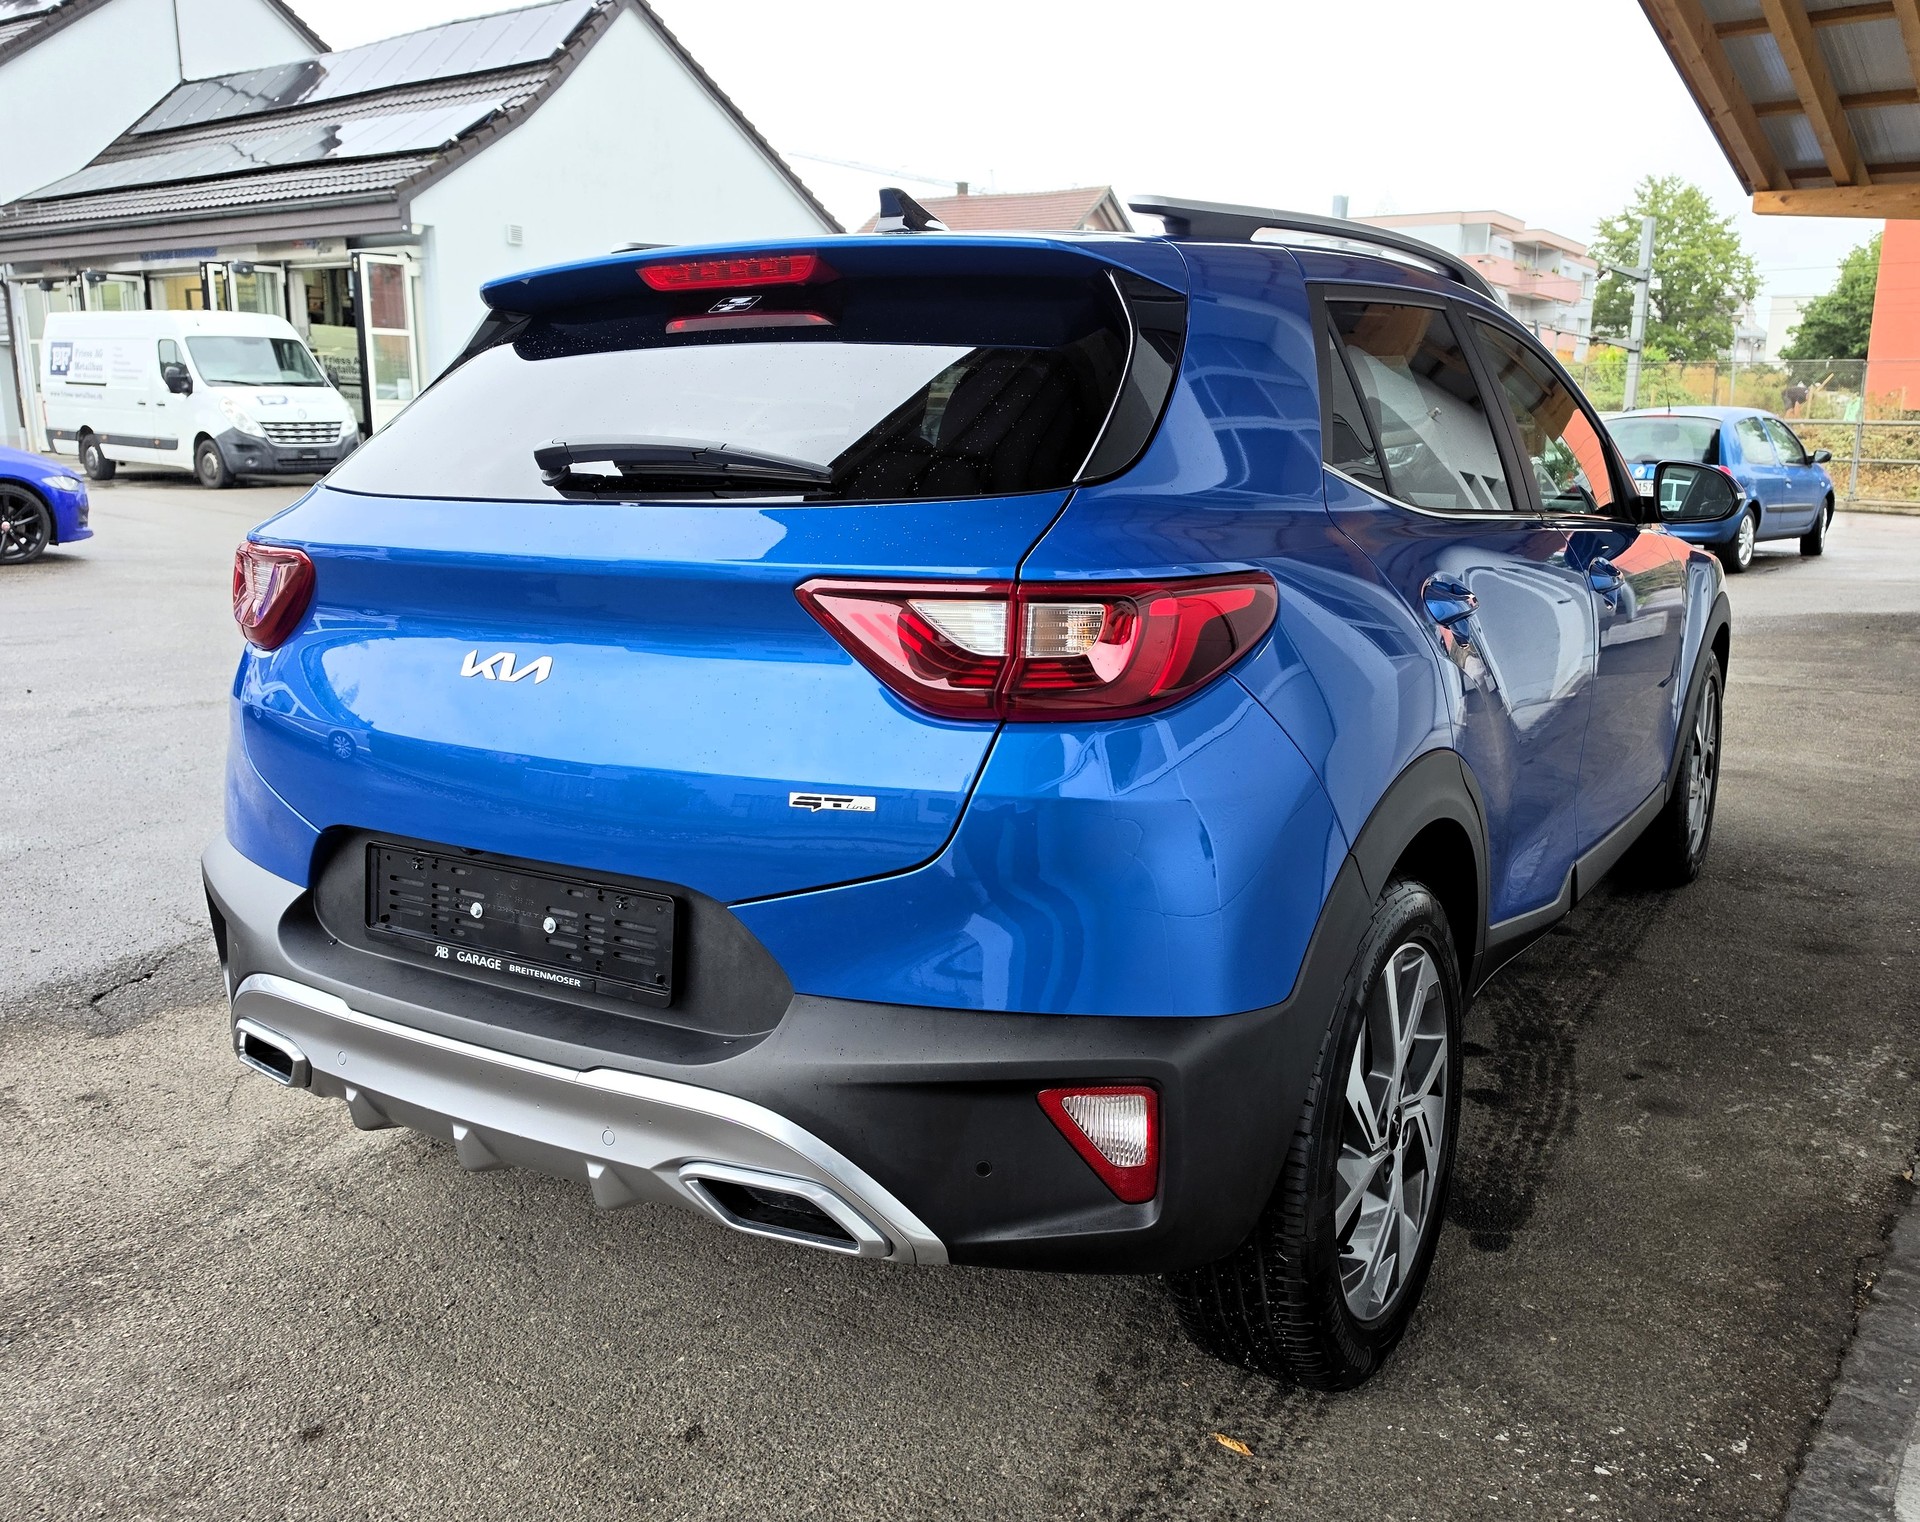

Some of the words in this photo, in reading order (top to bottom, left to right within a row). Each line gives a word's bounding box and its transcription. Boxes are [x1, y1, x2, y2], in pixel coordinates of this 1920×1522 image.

[460, 649, 554, 684] KIA
[456, 951, 502, 971] GARAGE
[509, 964, 581, 987] BREITENMOSER
